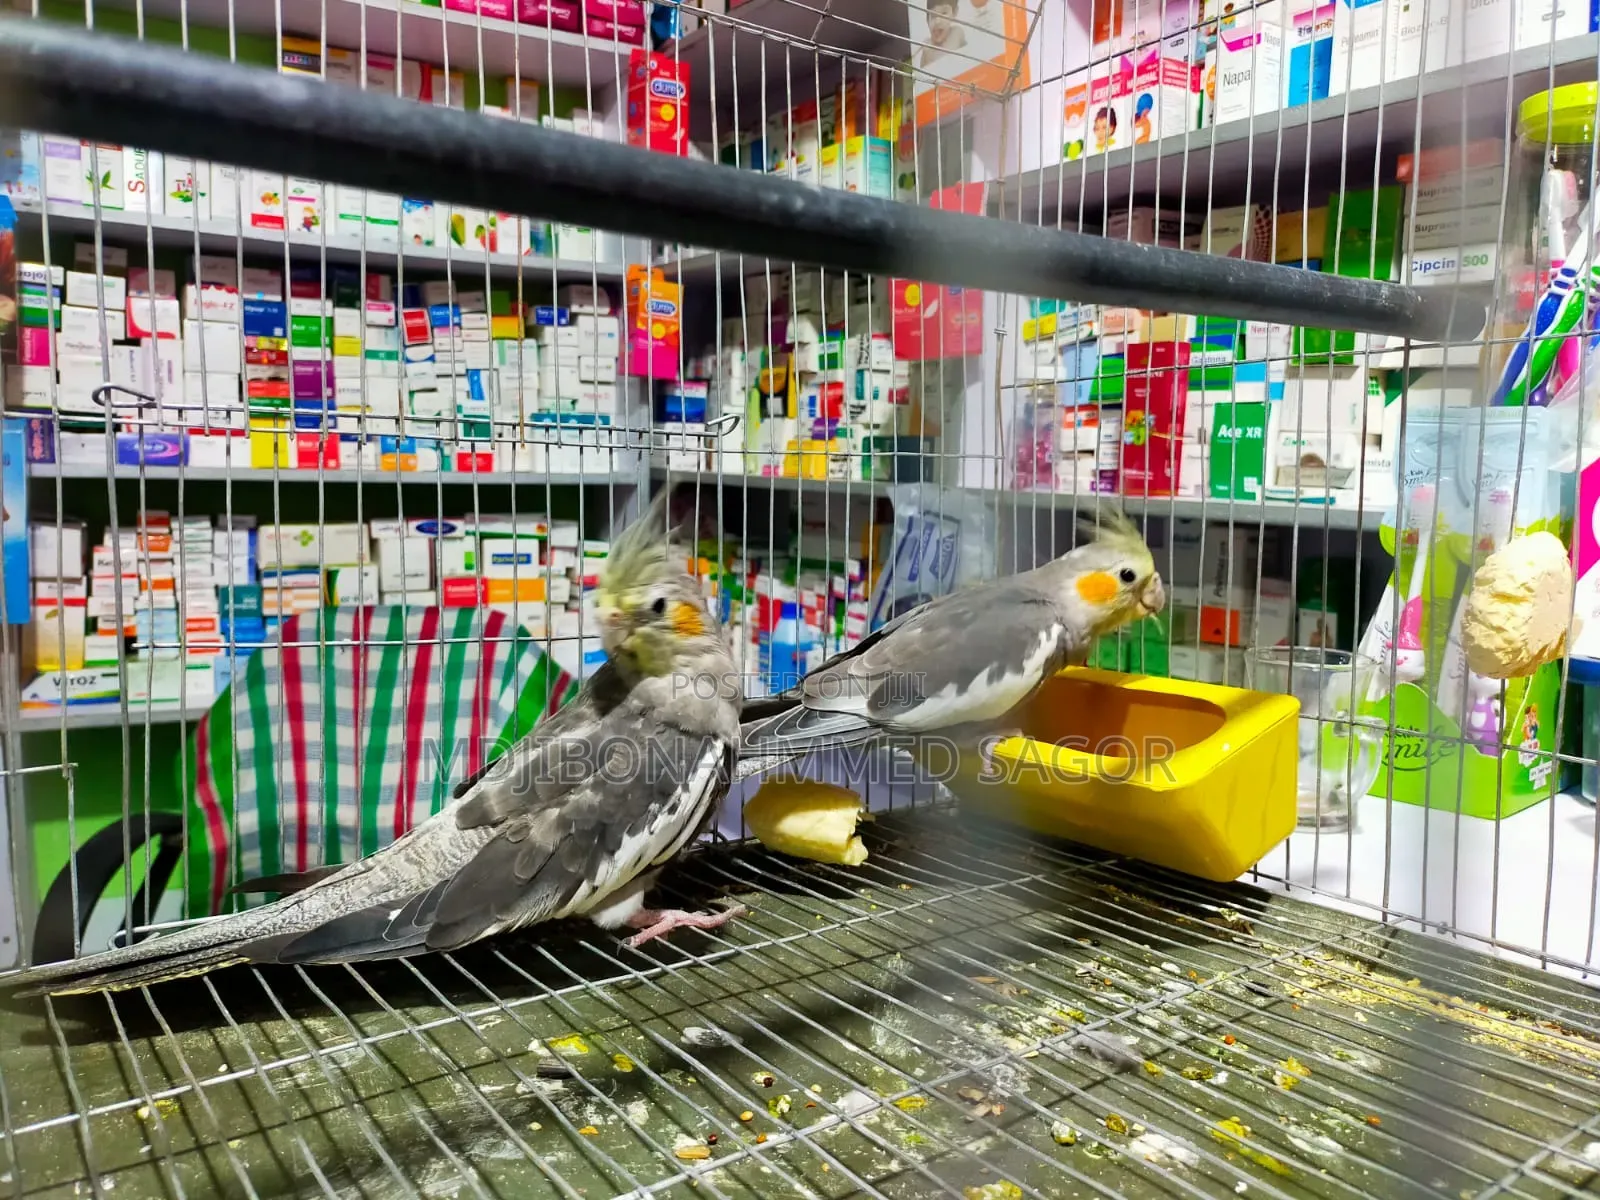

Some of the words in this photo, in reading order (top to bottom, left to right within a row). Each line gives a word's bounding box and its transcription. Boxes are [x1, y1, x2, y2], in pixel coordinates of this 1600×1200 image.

[1223, 68, 1251, 87] Napa
[1411, 257, 1456, 273] Cipcin
[1462, 254, 1489, 267] 500
[1245, 426, 1263, 439] XR
